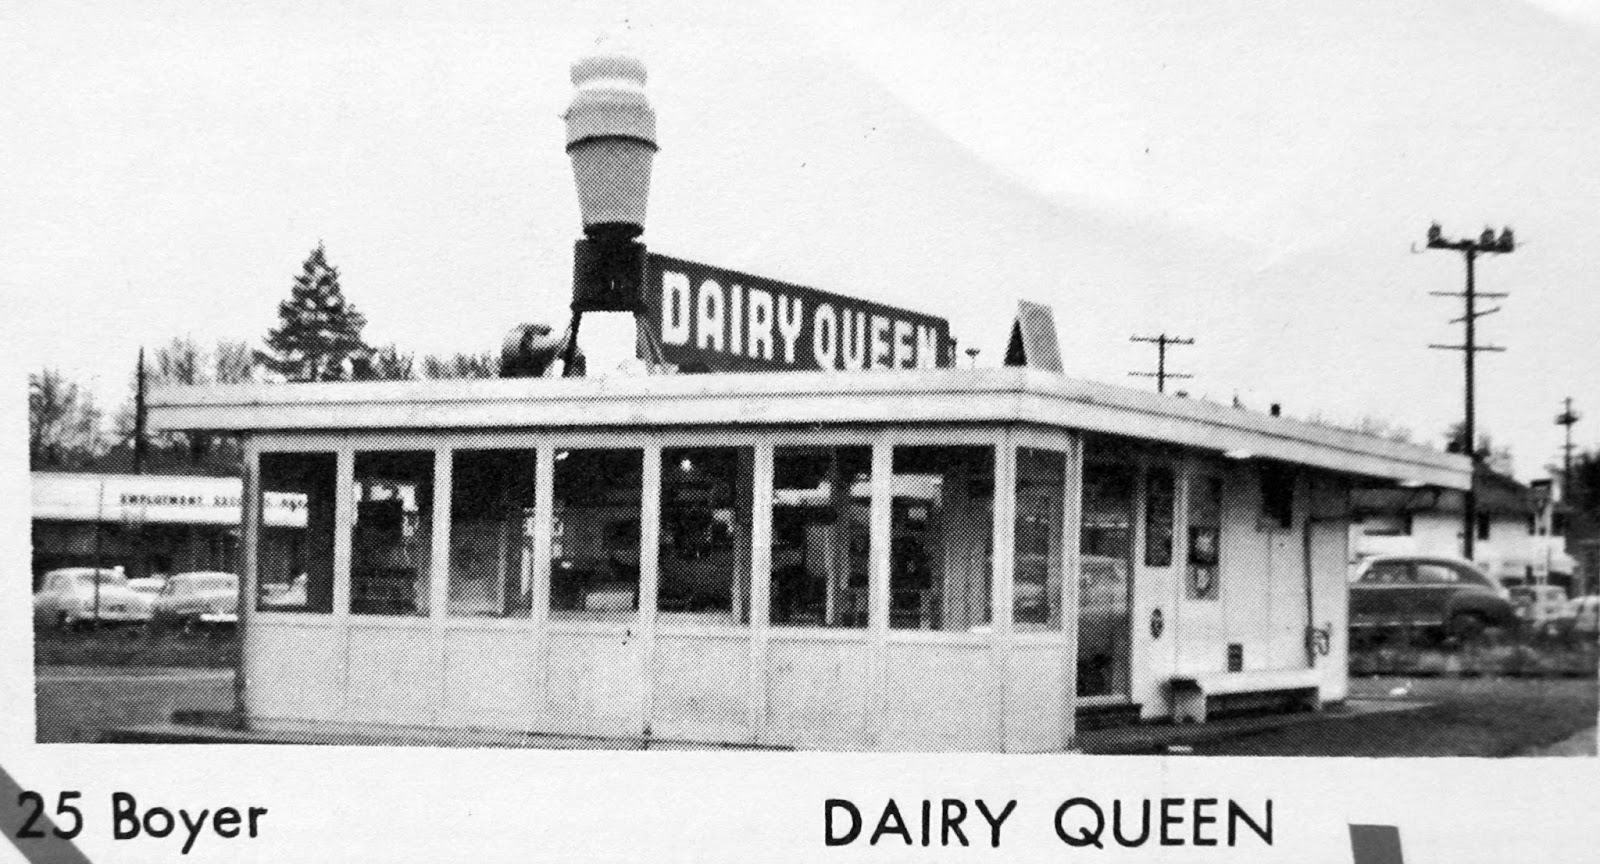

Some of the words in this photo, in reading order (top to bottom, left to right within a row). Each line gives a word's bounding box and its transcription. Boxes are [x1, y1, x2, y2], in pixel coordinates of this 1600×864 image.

[661, 270, 803, 364] DAIRY
[812, 302, 938, 371] QUEEN
[15, 790, 84, 840] 25
[112, 791, 268, 855] Boyer
[824, 798, 1017, 848] DAIRY
[1054, 797, 1273, 850] QUEEN
